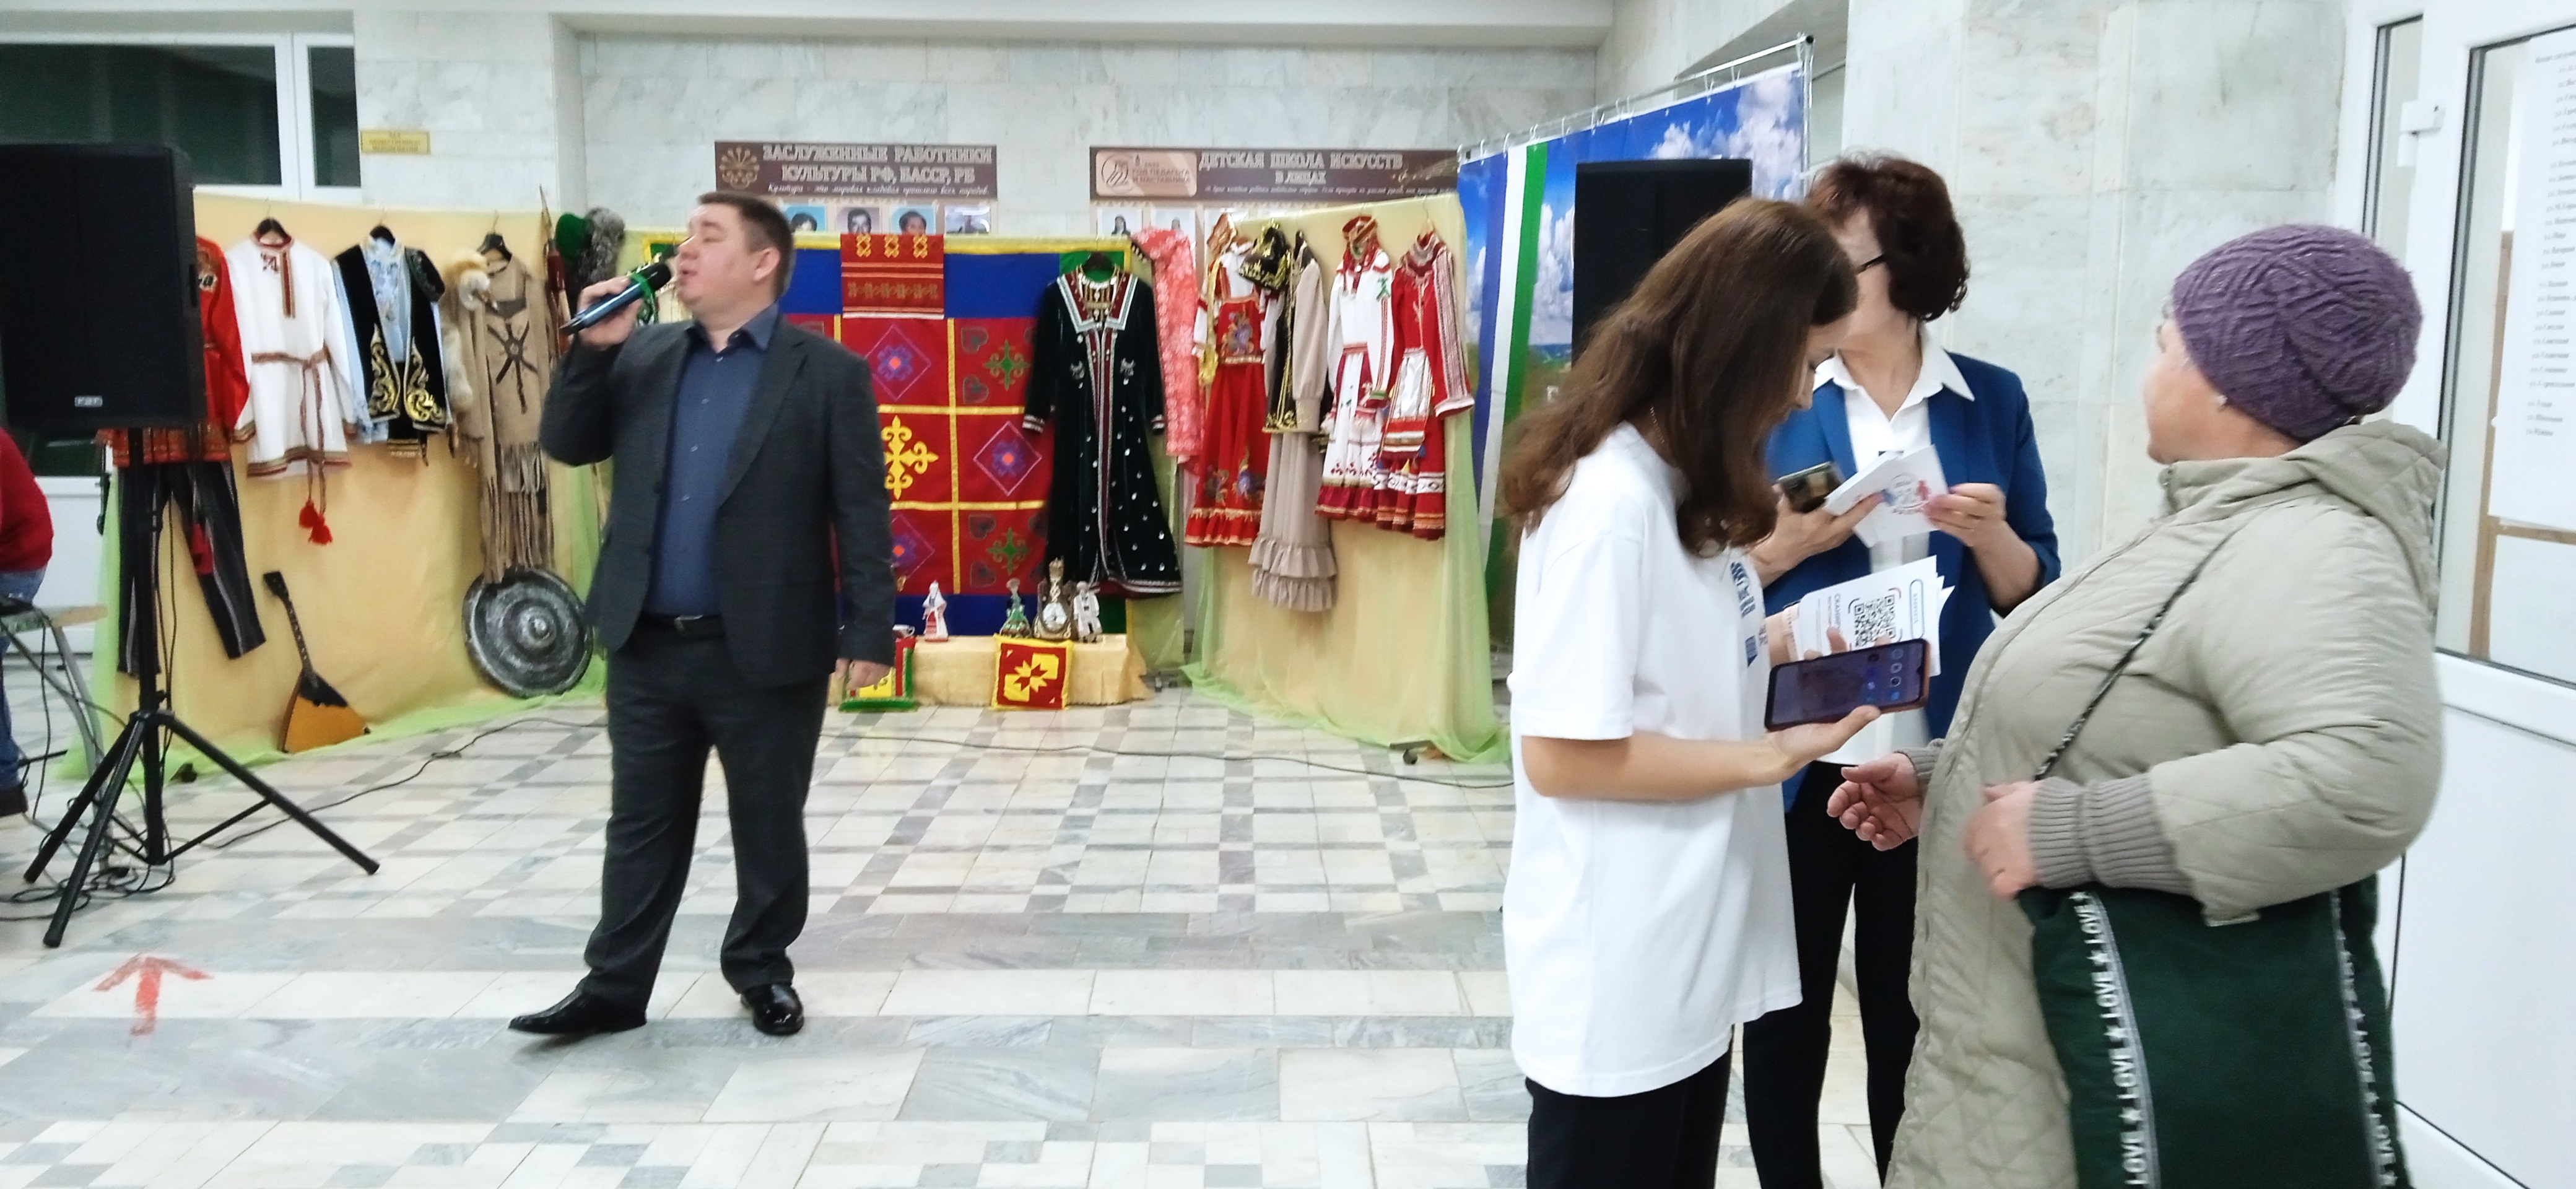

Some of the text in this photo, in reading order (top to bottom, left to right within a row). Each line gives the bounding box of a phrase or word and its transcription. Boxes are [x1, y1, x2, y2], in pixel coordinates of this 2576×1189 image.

[762, 144, 993, 164] ЗАСЛУЖЕННЫЕ РАБОТНИКИ
[1198, 150, 1403, 172] ДЕТСКАЯ ШКОЛА ИСКУССТВ
[781, 163, 975, 185] КУЛЬТУРЫ РФ, БАССР, РБ
[1274, 169, 1326, 186] В ЛИЦАХ
[2074, 904, 2149, 1185] LOVE LOVE LOVE LOVE
